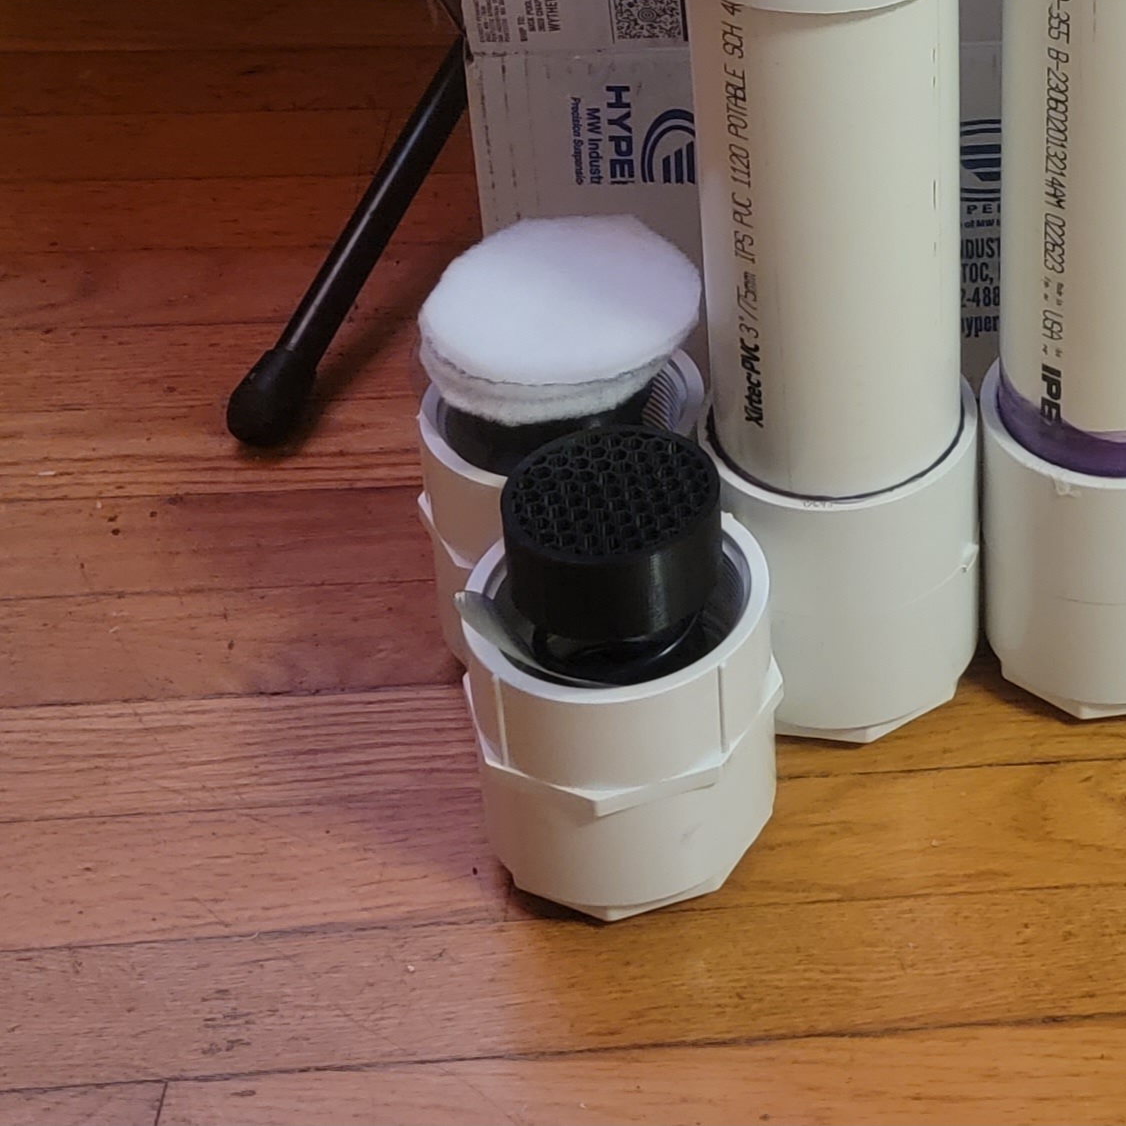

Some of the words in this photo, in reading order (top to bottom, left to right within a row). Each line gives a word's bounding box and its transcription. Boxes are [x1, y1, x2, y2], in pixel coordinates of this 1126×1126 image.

[722, 21, 744, 59] SCH
[571, 97, 582, 136] Precision
[724, 63, 749, 140] POTABLE
[586, 108, 602, 134] MW
[729, 143, 751, 188] 1120
[731, 192, 754, 229] PVC
[734, 230, 755, 264] IPS
[1043, 310, 1063, 340] USA
